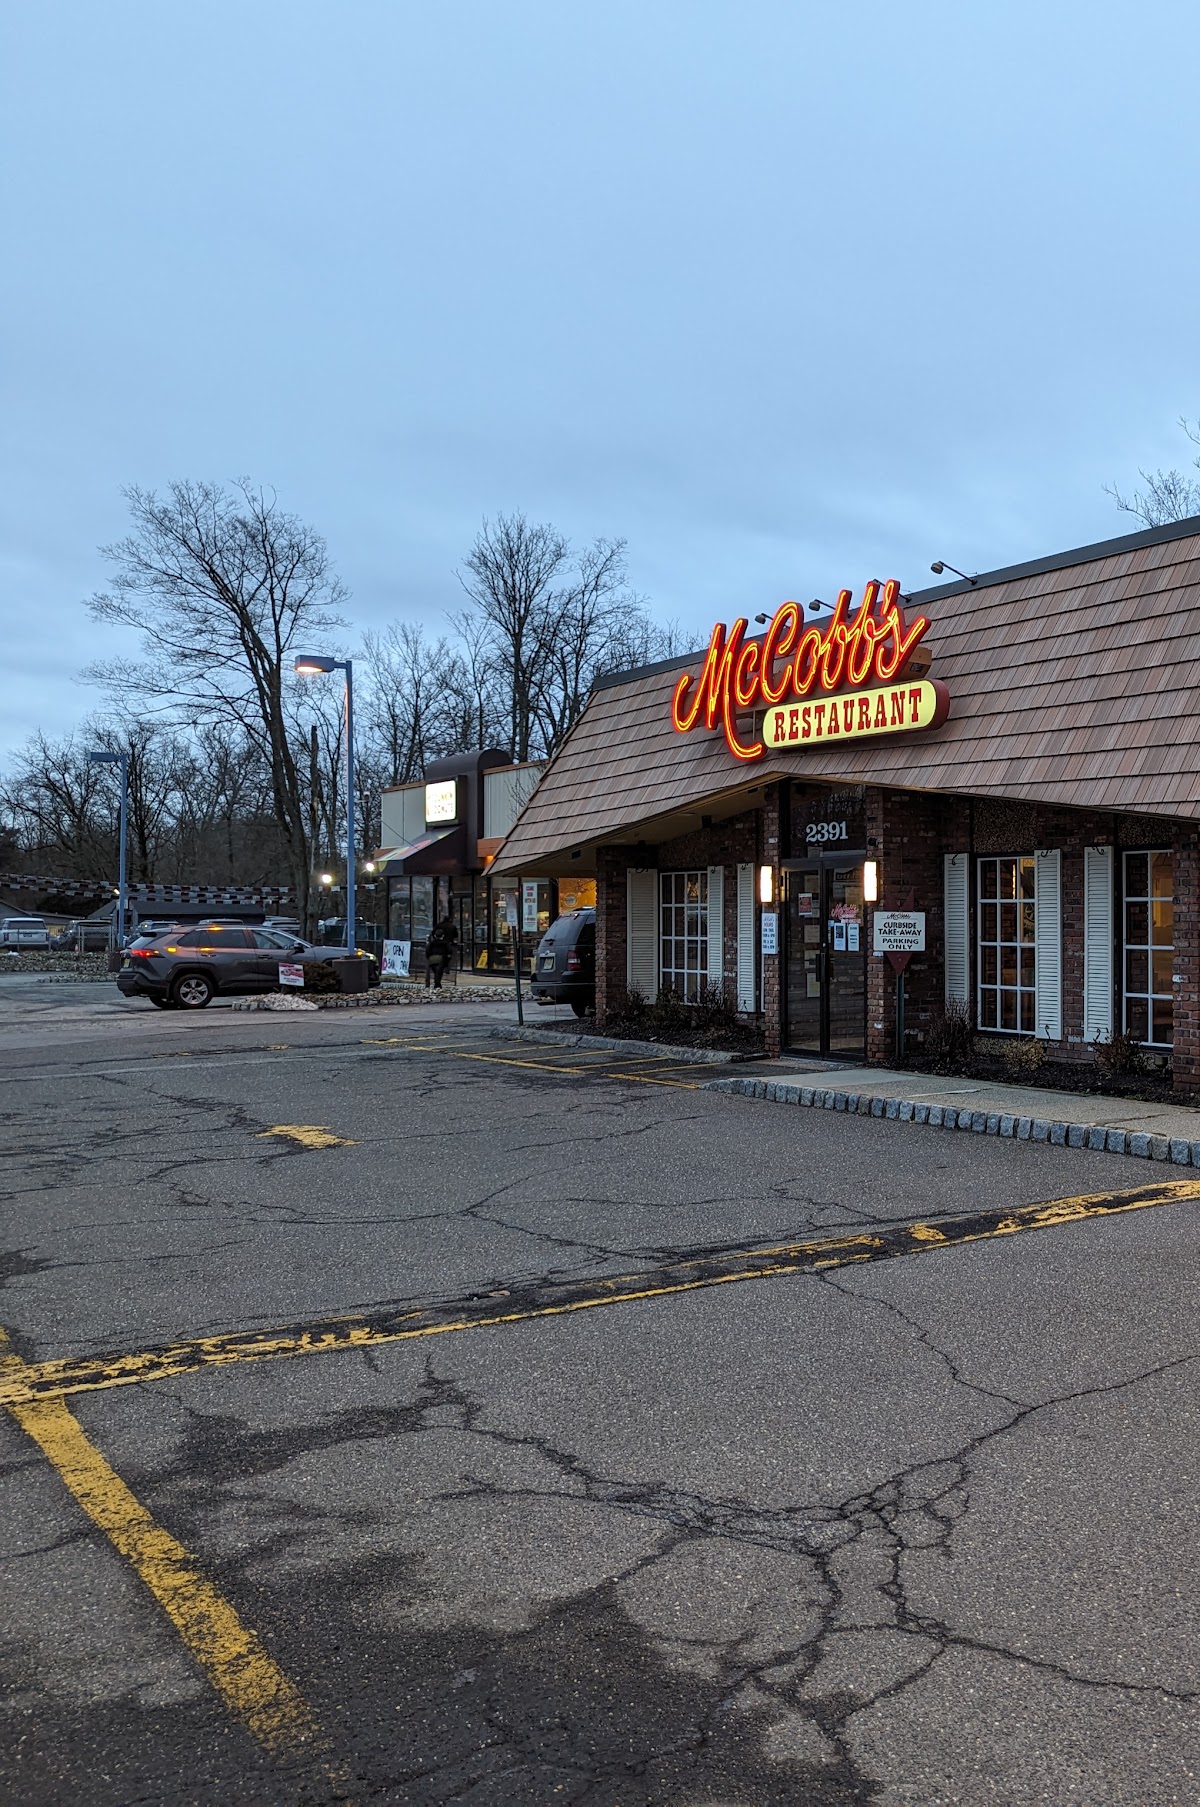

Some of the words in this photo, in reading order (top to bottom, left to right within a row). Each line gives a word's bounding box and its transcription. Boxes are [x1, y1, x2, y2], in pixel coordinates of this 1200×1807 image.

[672, 579, 932, 761] McCobb's
[773, 688, 922, 742] RESTAURANT
[806, 821, 848, 842] 2391
[878, 928, 922, 936] TAKE-AWAY
